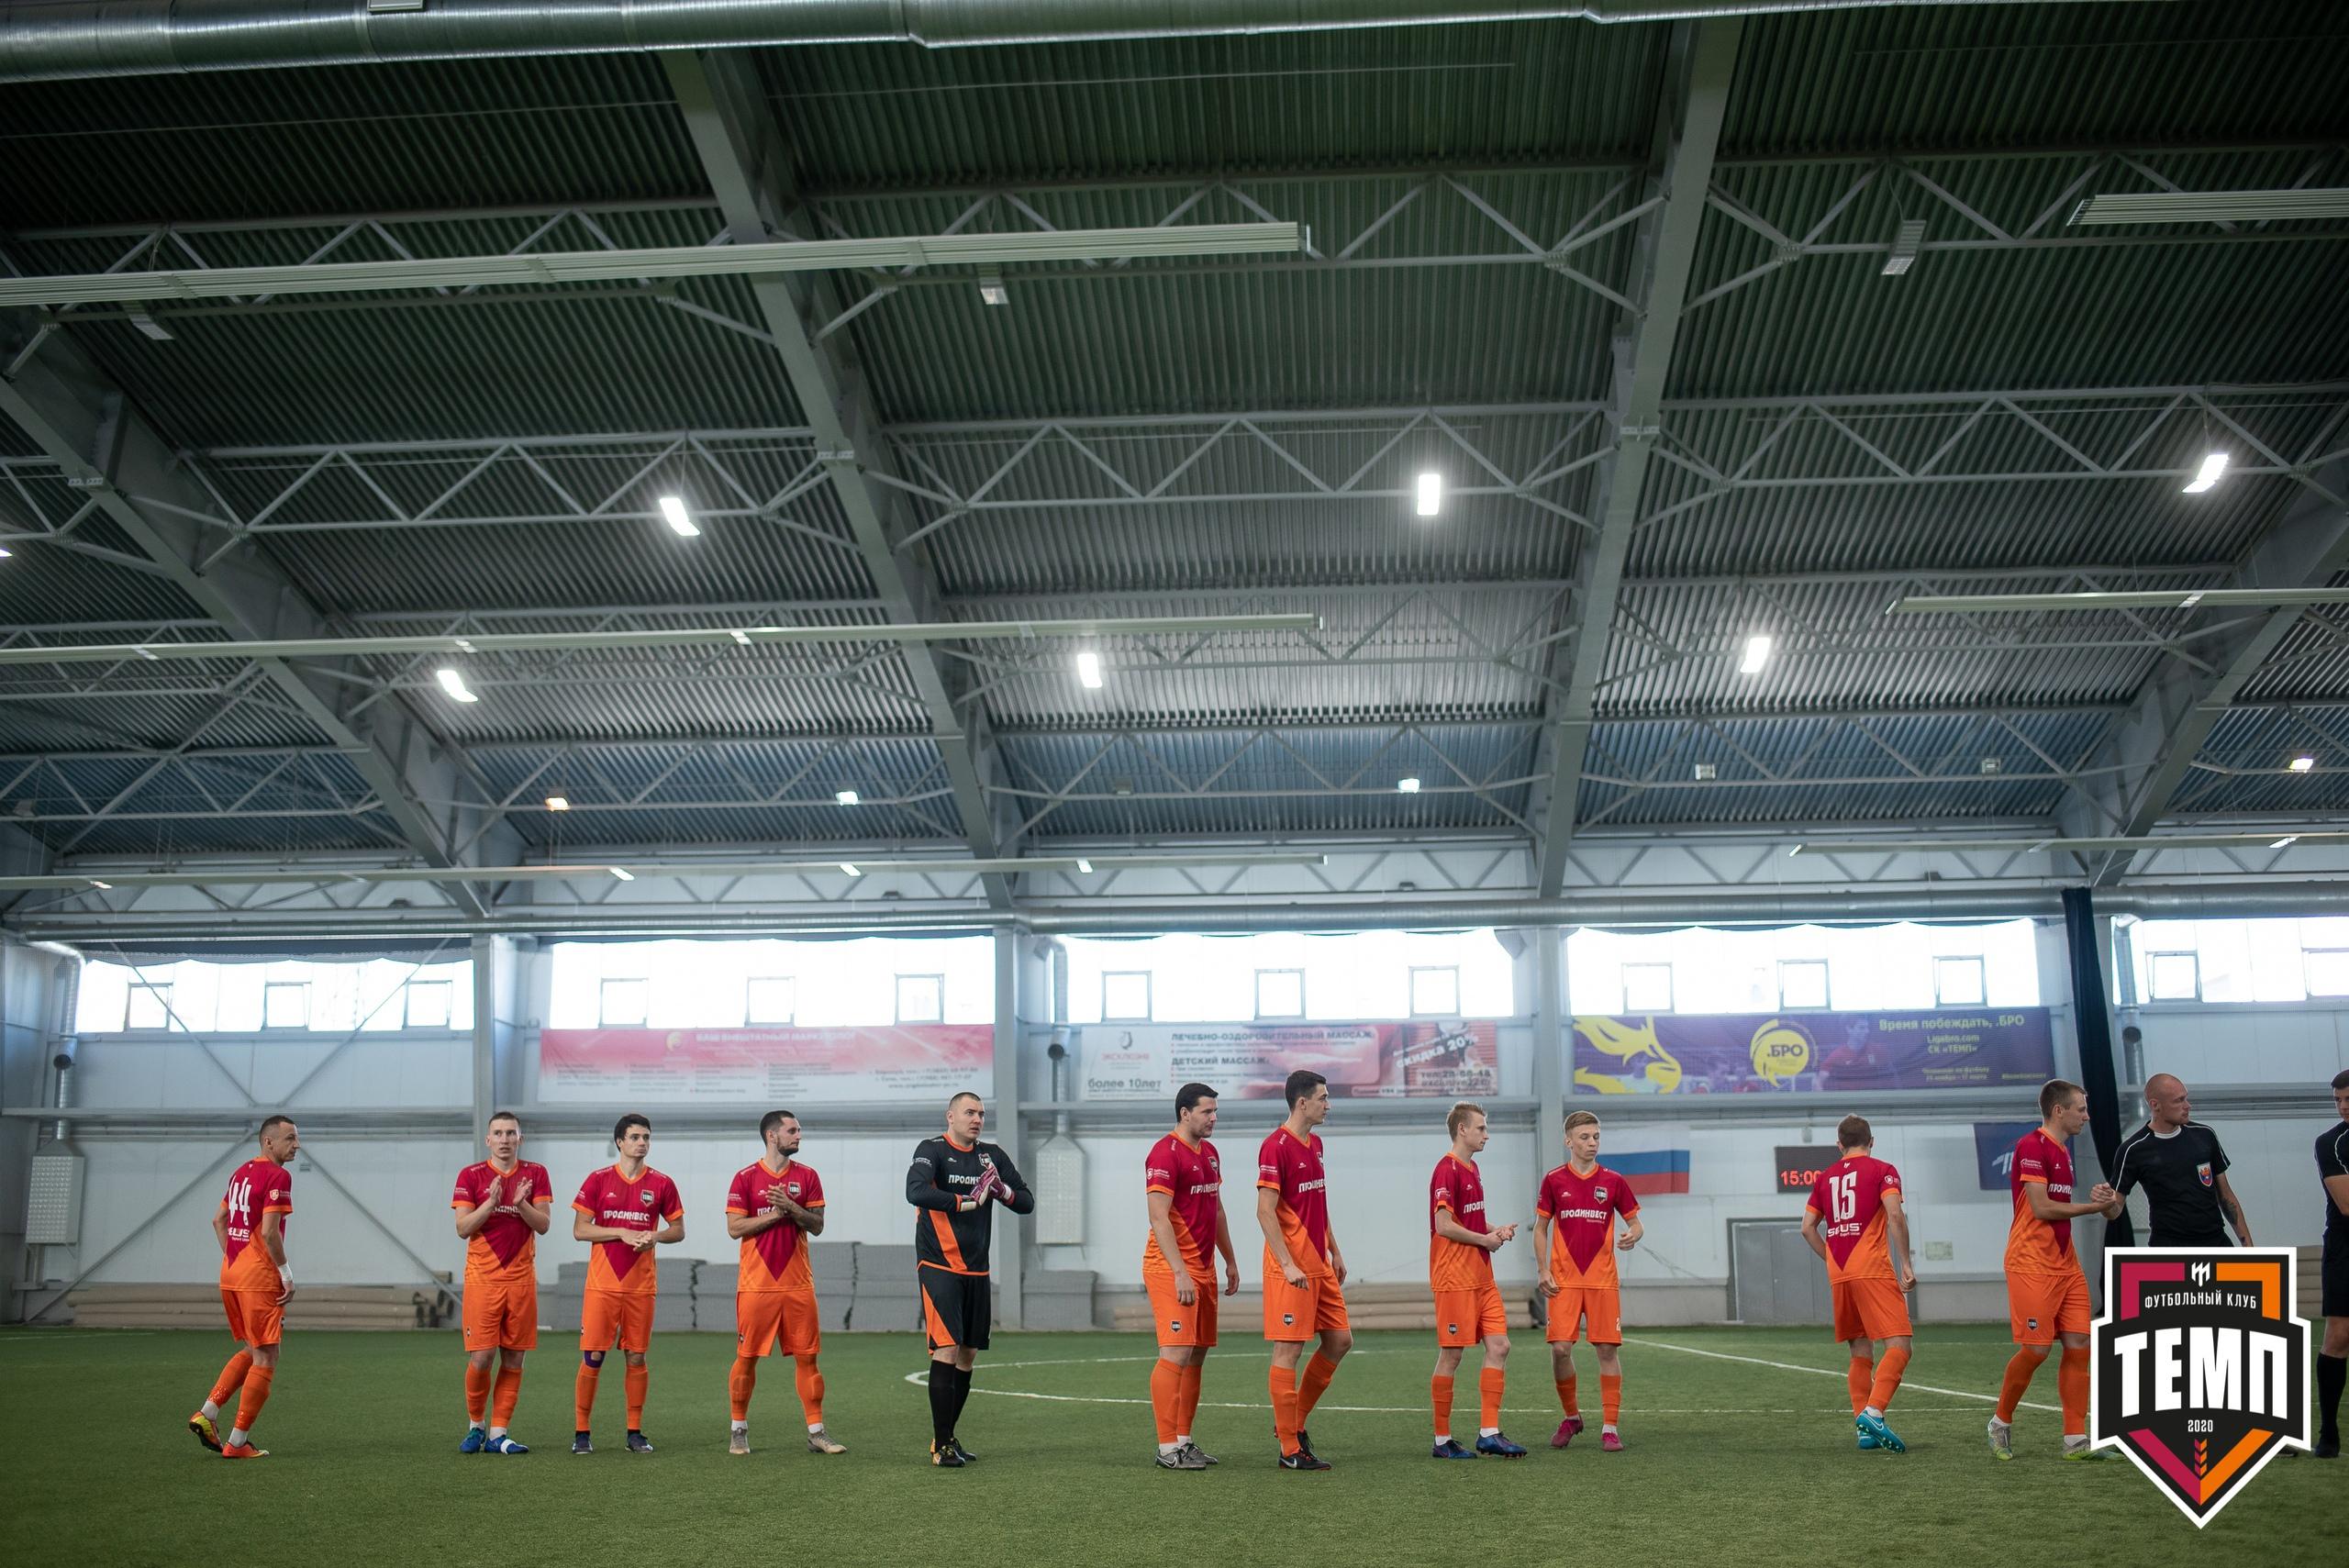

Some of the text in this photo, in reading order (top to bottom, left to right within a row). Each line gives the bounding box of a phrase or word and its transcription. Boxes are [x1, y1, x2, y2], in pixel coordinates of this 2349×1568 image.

[228, 1174, 251, 1226] 44
[603, 1210, 651, 1221] ПРОДИНВЕС
[1829, 1171, 1857, 1223] 15
